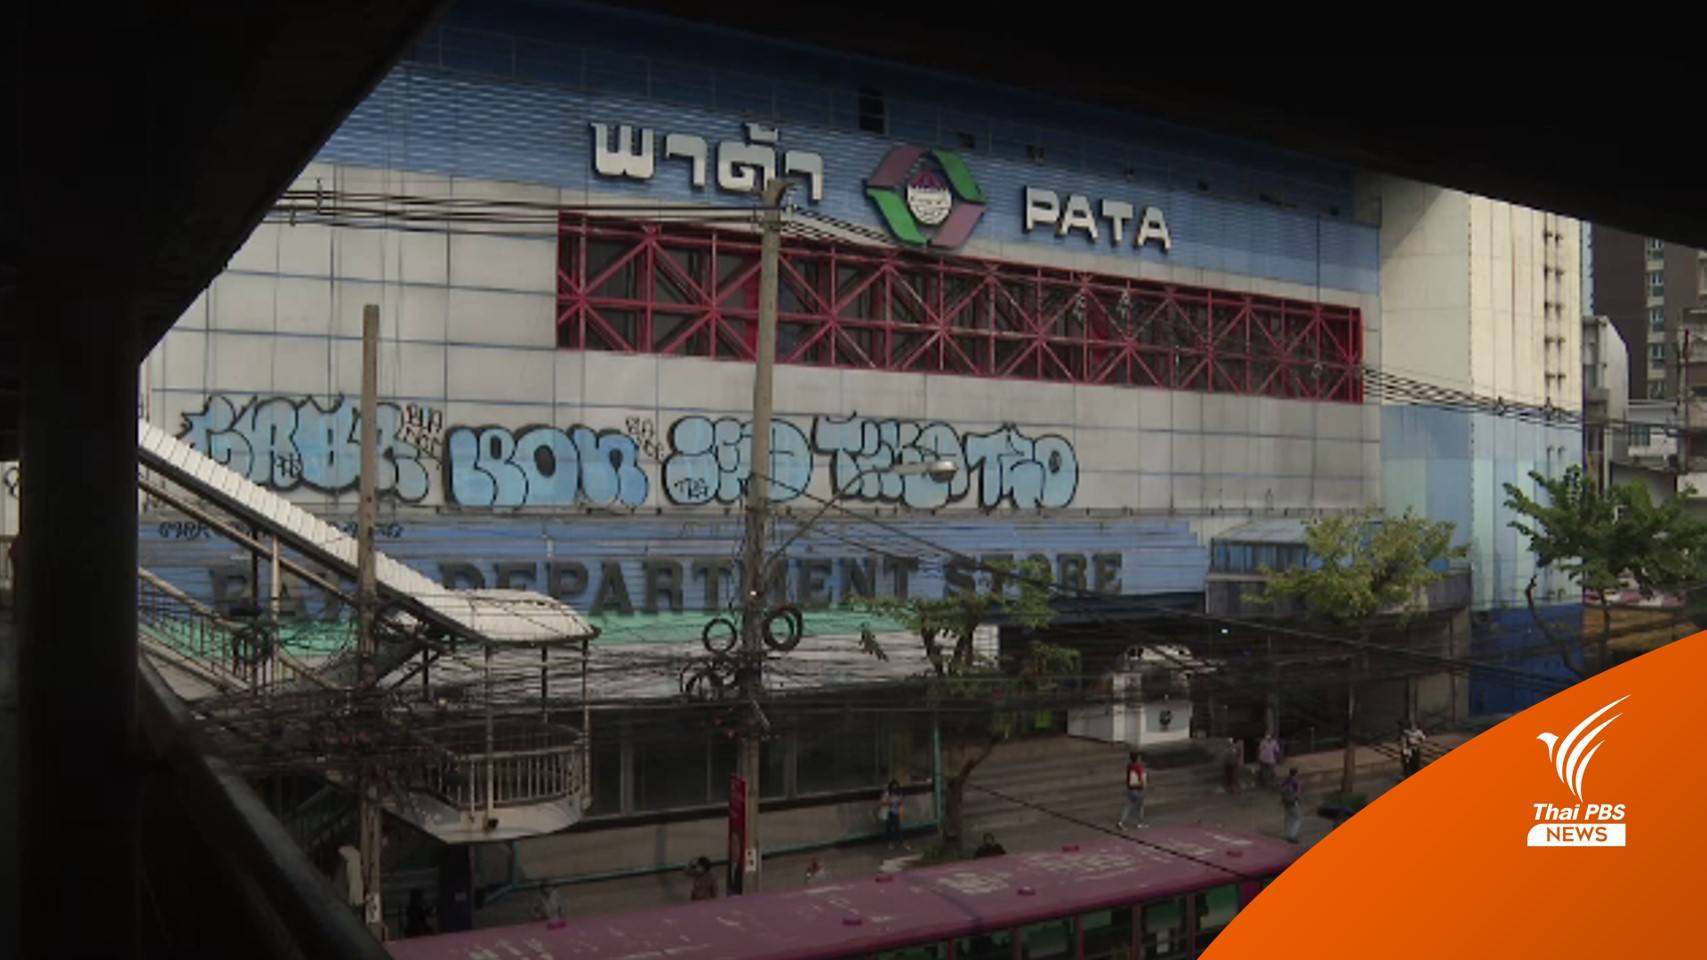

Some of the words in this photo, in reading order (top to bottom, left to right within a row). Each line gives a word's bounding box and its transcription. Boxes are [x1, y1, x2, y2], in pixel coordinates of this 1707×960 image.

[590, 122, 824, 202] พาต้า
[1024, 186, 1171, 251] PATA
[440, 556, 917, 615] DEPARTMENT
